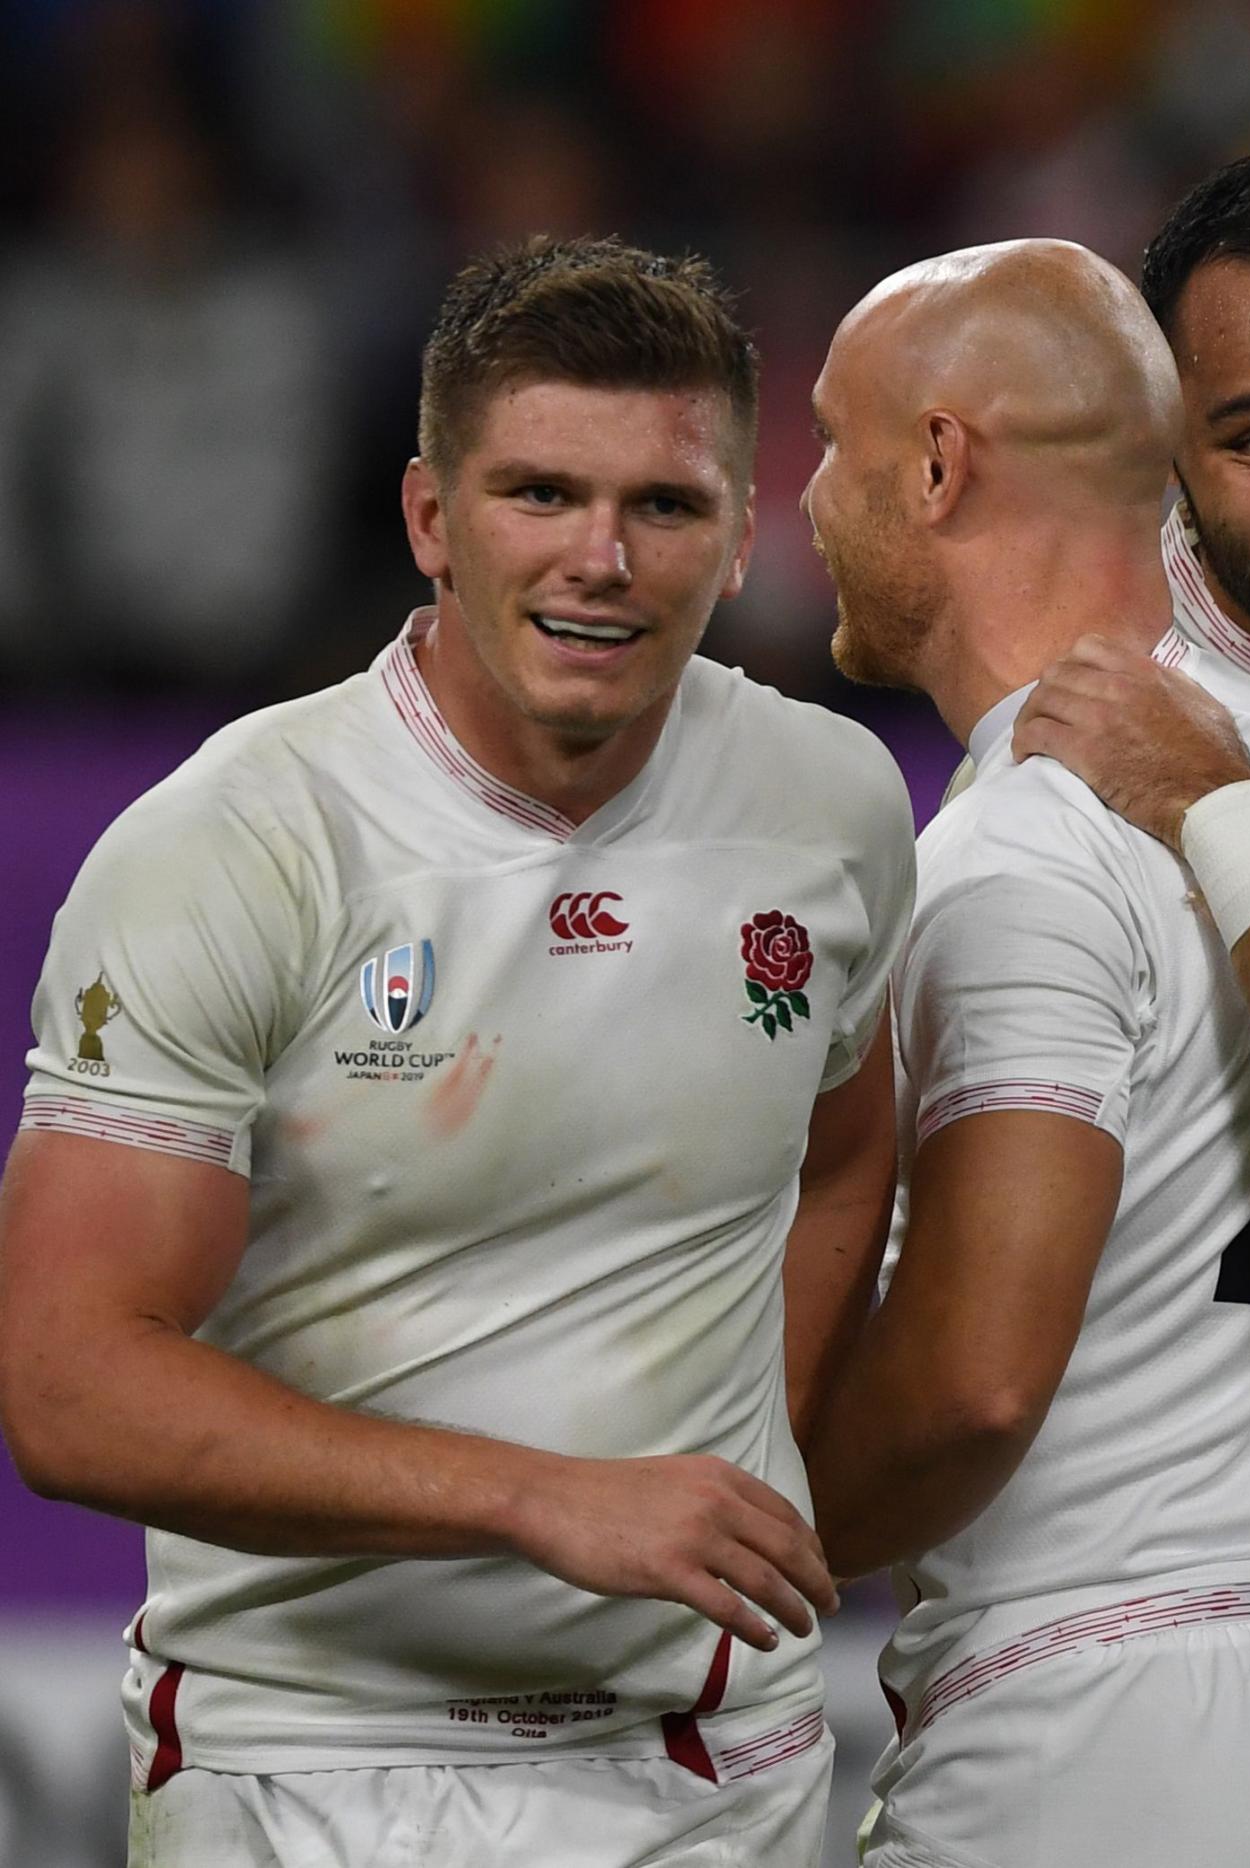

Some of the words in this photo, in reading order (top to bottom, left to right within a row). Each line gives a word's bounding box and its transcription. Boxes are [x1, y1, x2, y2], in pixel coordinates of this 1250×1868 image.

[549, 940, 633, 956] canterbury
[369, 1040, 413, 1051] RUGBY
[334, 1051, 404, 1067] WORLD
[67, 1057, 111, 1078] 2003
[346, 1070, 381, 1080] JAPAN
[525, 1694, 534, 1704] v
[539, 1690, 617, 1705] Australia
[448, 1707, 489, 1723] 19th
[497, 1709, 565, 1725] October
[511, 1727, 547, 1739] Oita
